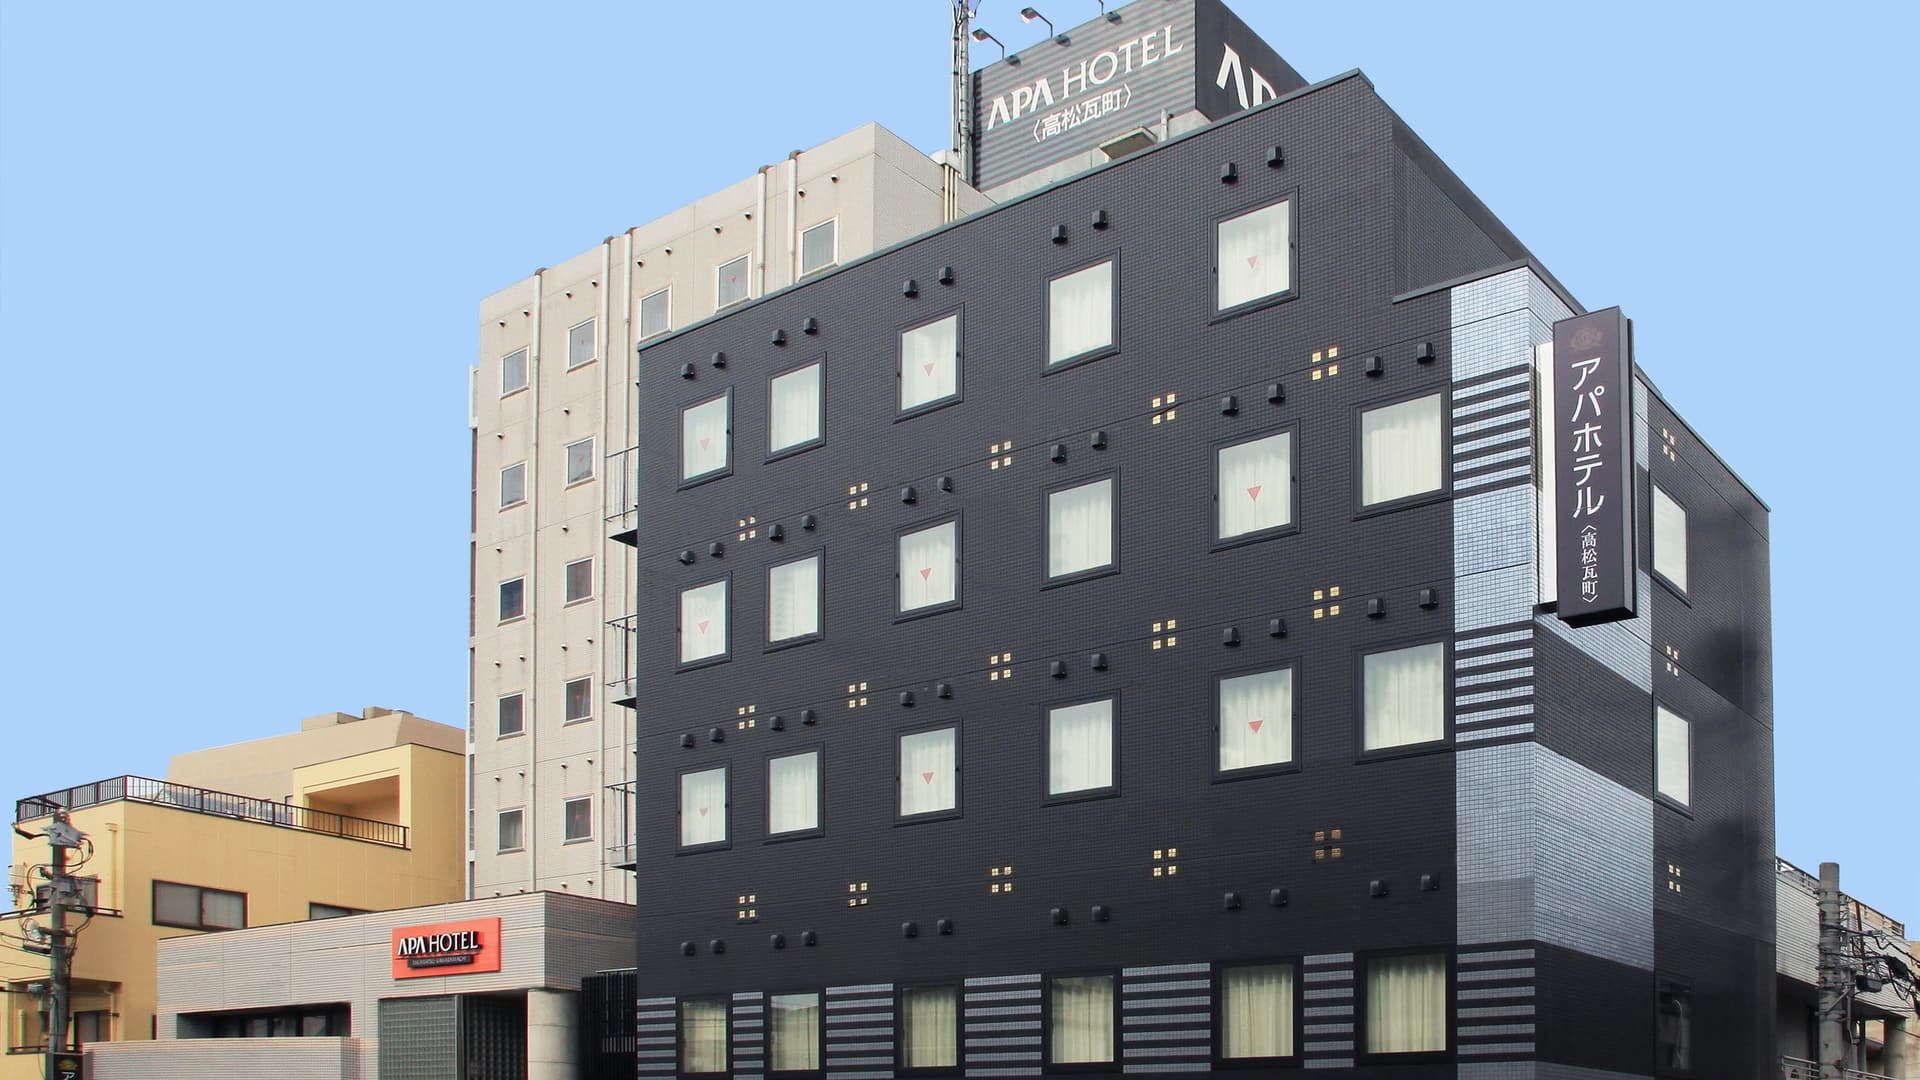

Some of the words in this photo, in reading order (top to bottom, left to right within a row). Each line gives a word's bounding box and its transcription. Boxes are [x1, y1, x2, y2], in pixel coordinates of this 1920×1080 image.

[987, 78, 1054, 130] APA
[1062, 25, 1184, 99] HOTEL
[1571, 357, 1605, 518] アパホテル
[398, 936, 426, 955] APA
[429, 930, 478, 952] HOTEL
